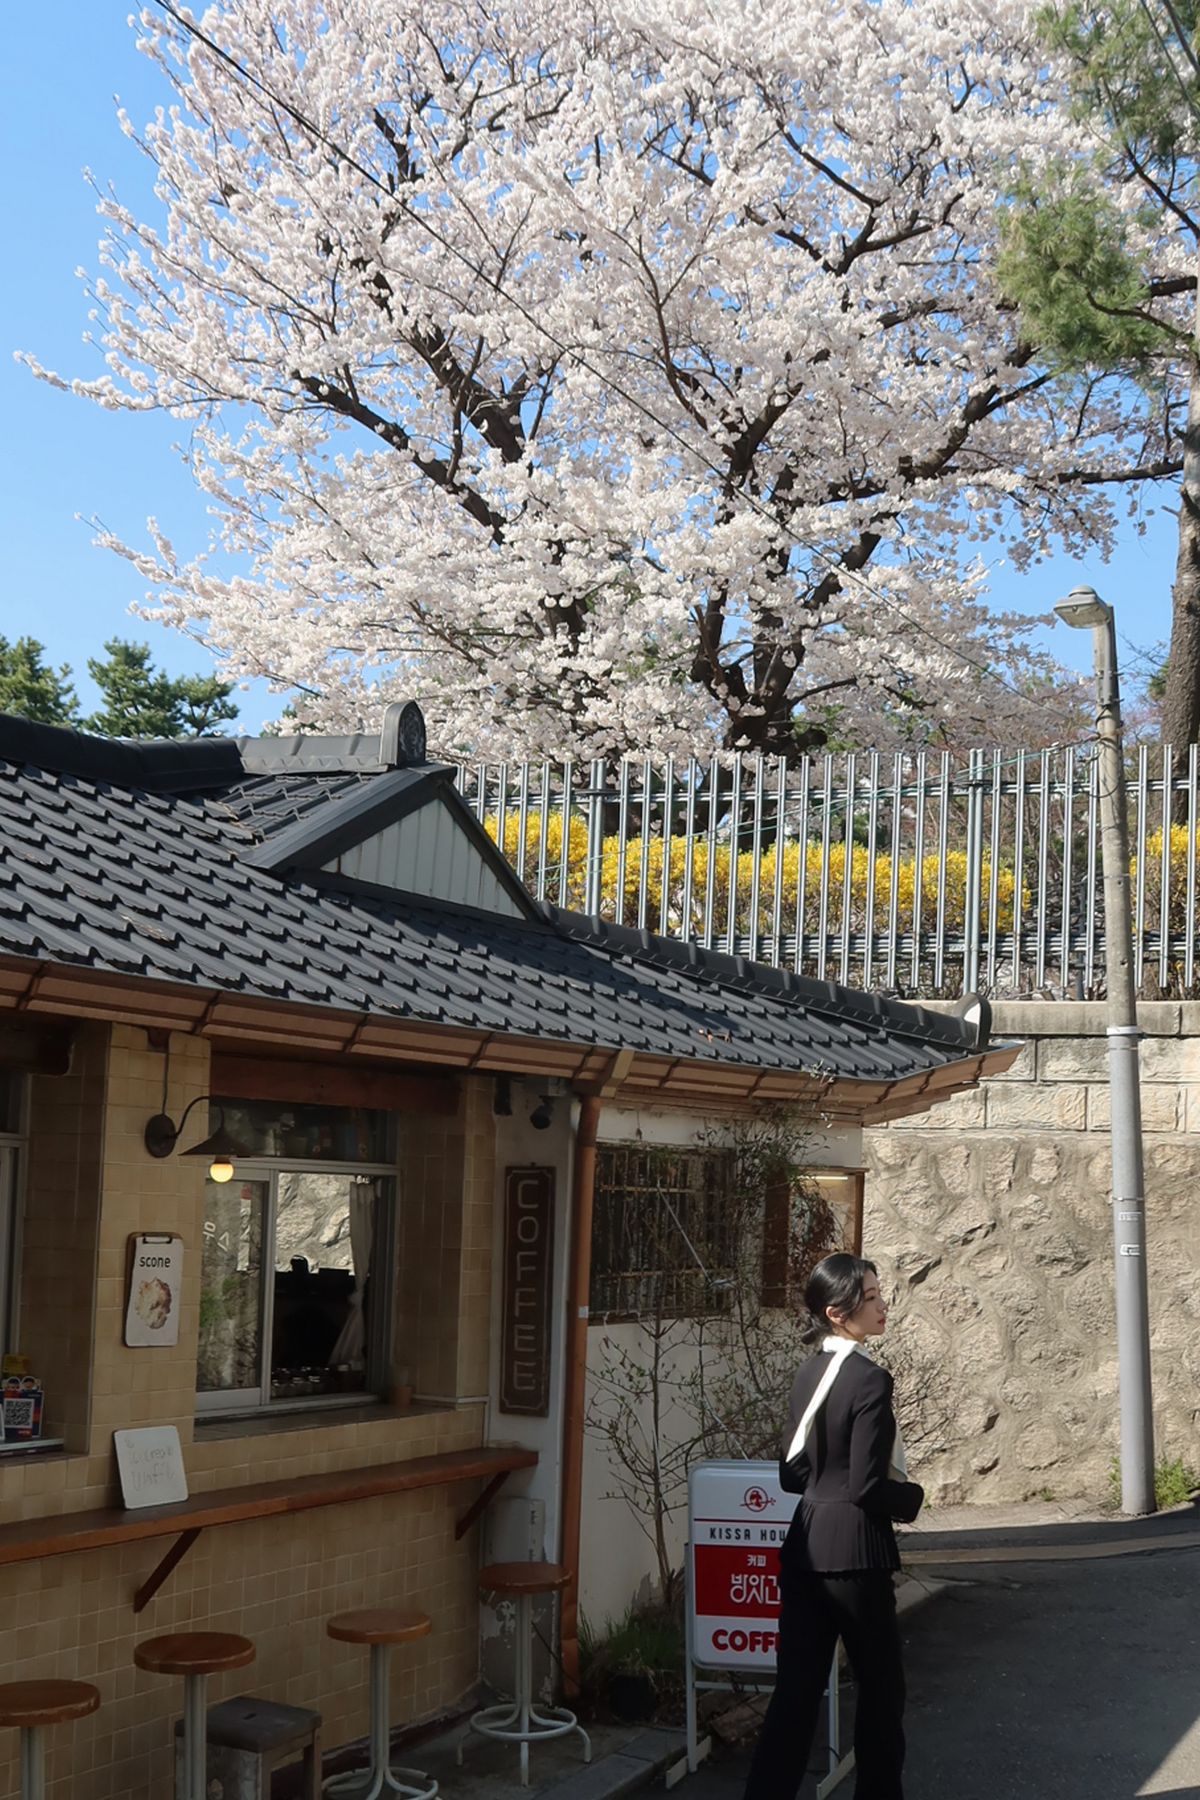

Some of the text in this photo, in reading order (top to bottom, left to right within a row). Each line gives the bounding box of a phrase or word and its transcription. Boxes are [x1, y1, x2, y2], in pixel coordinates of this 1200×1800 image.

[139, 1256, 171, 1268] scone
[513, 1179, 539, 1391] COFFEE
[709, 1527, 787, 1542] KISSA HOU
[747, 1554, 767, 1567] 커피
[711, 1628, 780, 1653] COFF
